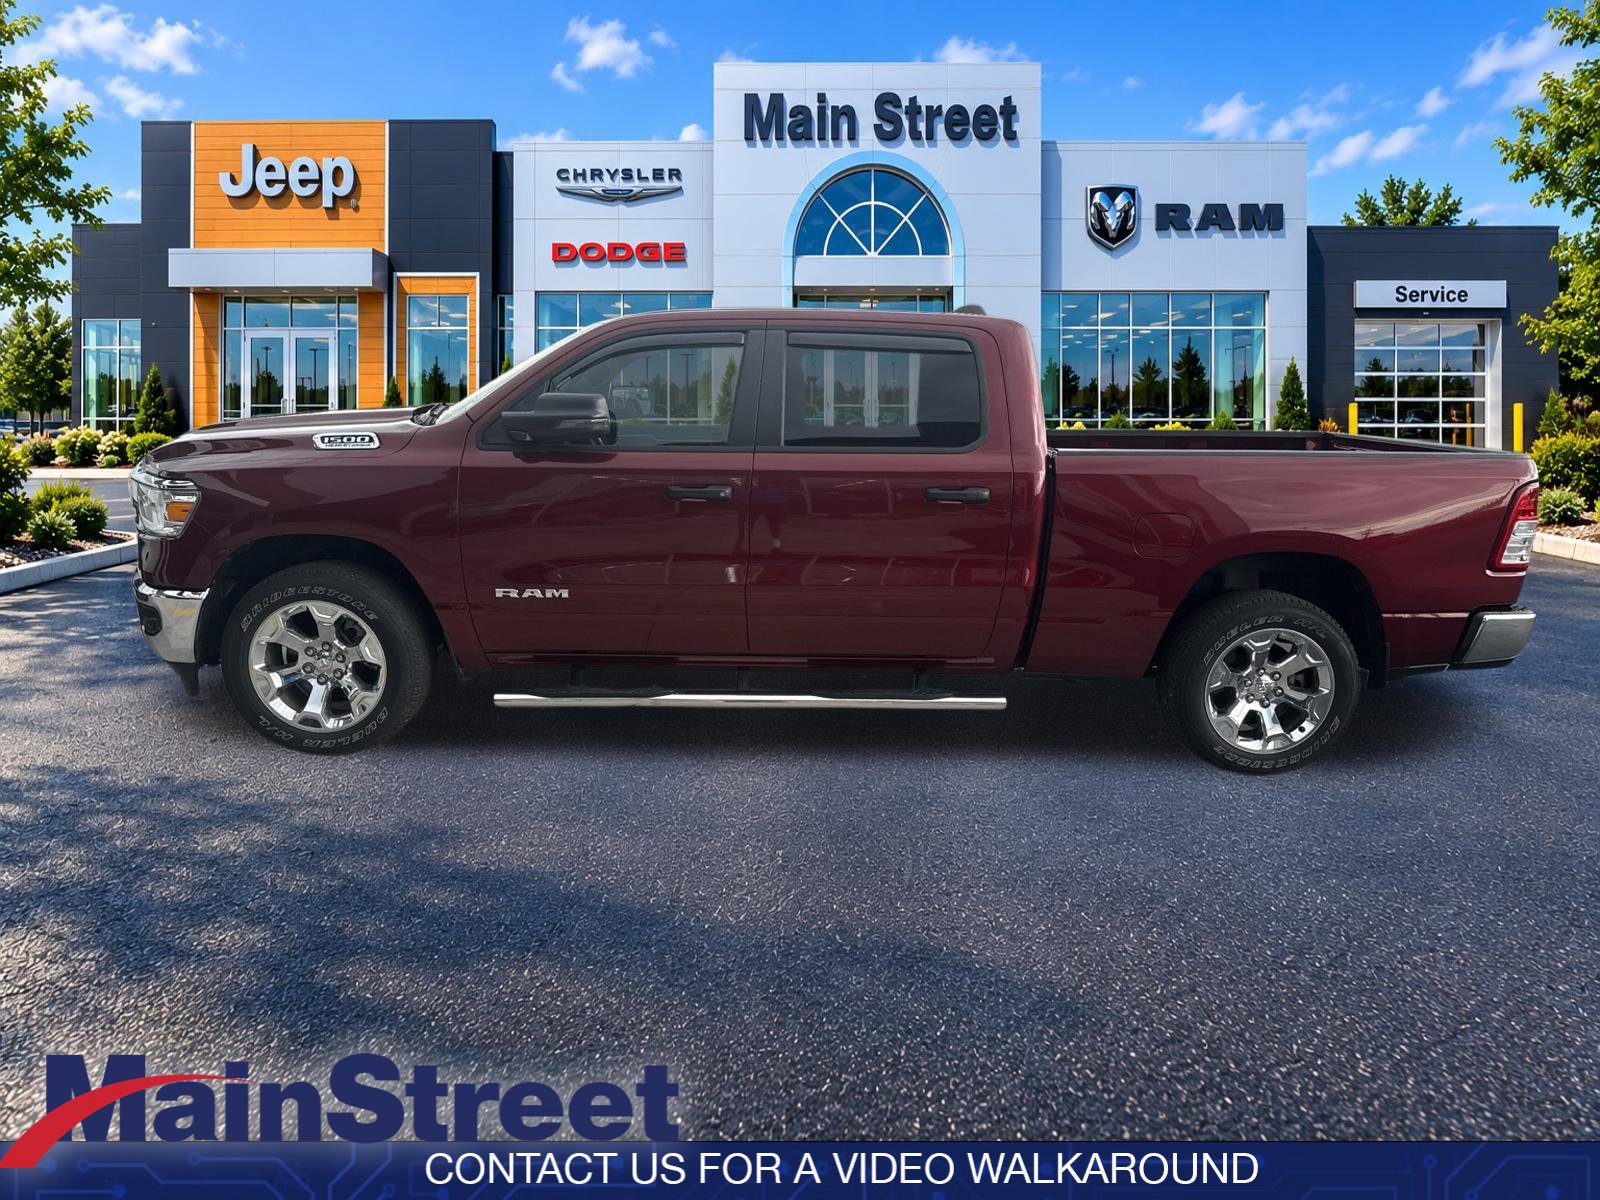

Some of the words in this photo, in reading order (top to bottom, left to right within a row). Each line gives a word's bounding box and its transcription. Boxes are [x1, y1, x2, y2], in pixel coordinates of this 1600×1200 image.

[744, 93, 856, 142] Main
[874, 92, 1018, 142] Street
[219, 143, 355, 209] Jeep
[556, 168, 682, 183] CHRYSLER
[1155, 203, 1284, 232] RAM
[552, 242, 687, 263] DODGE
[1395, 285, 1469, 303] Service
[323, 436, 370, 444] 1500
[494, 588, 569, 599] RAM
